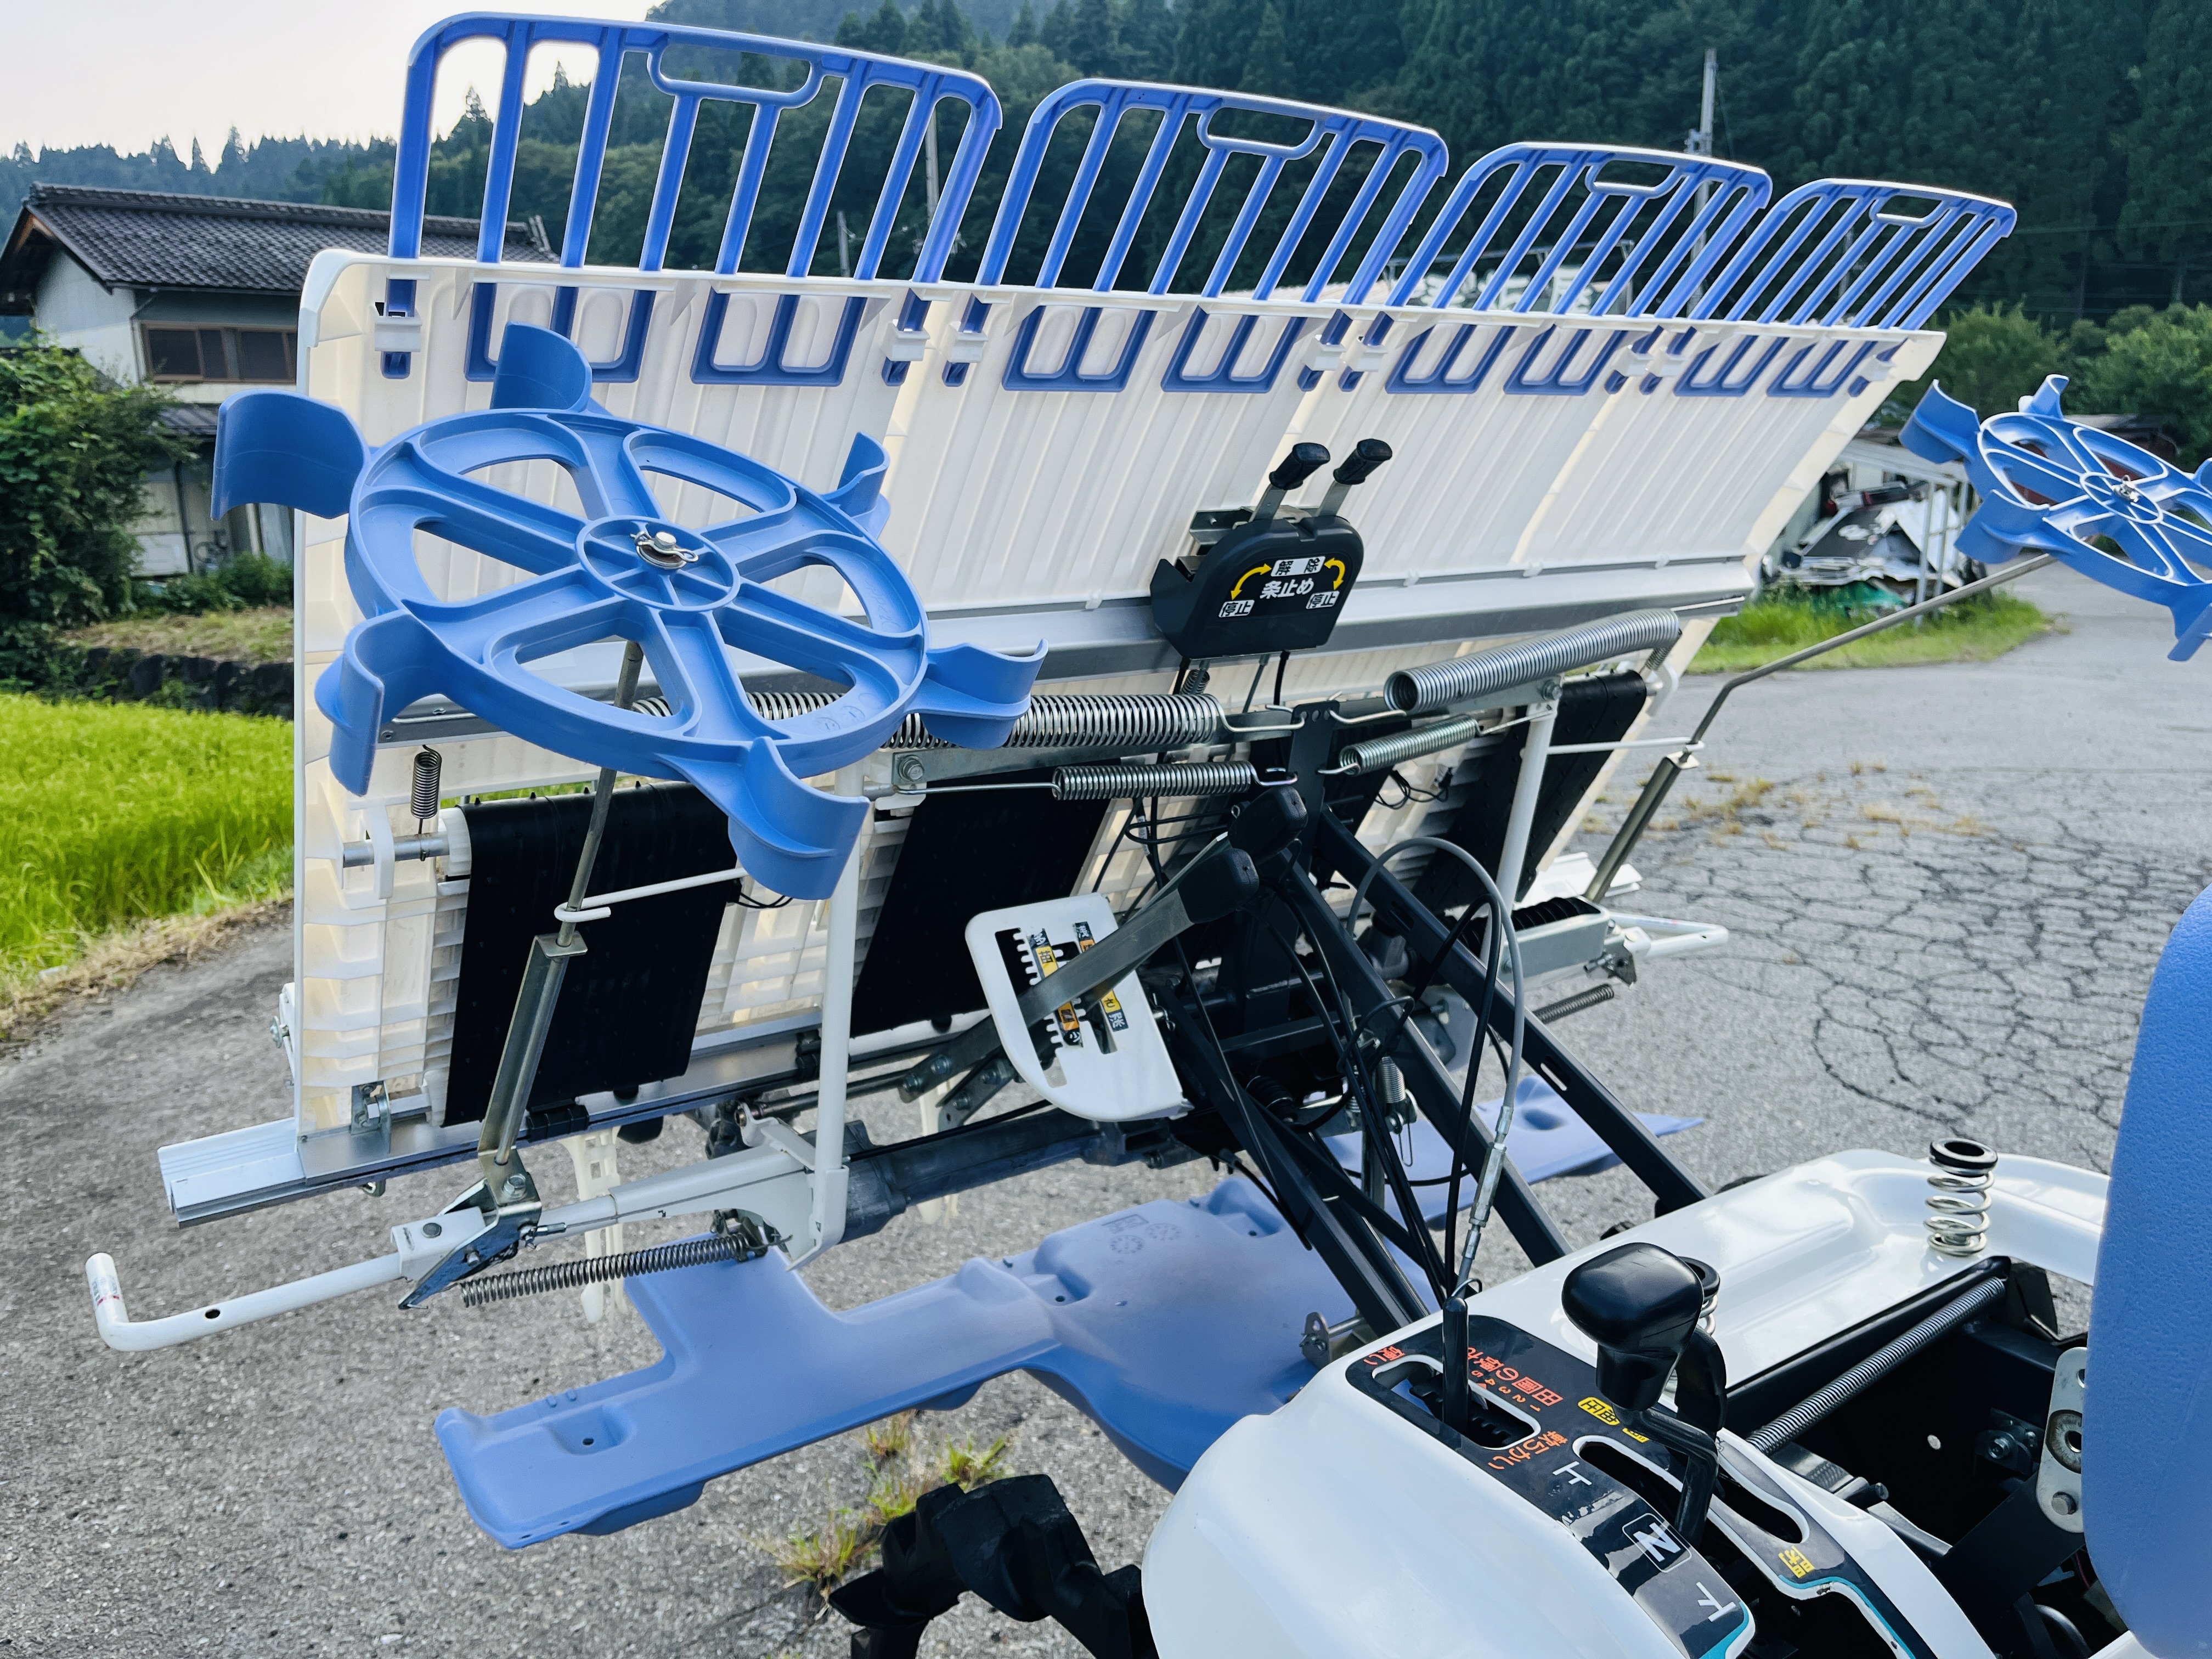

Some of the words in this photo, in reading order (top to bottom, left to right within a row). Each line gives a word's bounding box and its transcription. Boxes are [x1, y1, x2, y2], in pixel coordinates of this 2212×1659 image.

[1260, 578, 1314, 599] 条止め
[1308, 593, 1336, 608] 停止
[1220, 601, 1251, 617] 停止
[1363, 1345, 1406, 1366] 硬い
[1485, 1378, 1496, 1386] 4
[1498, 1386, 1511, 1394] 3
[1512, 1394, 1526, 1403] 2
[1488, 1430, 1568, 1470] 軟らかい
[1633, 1522, 1681, 1562] N
